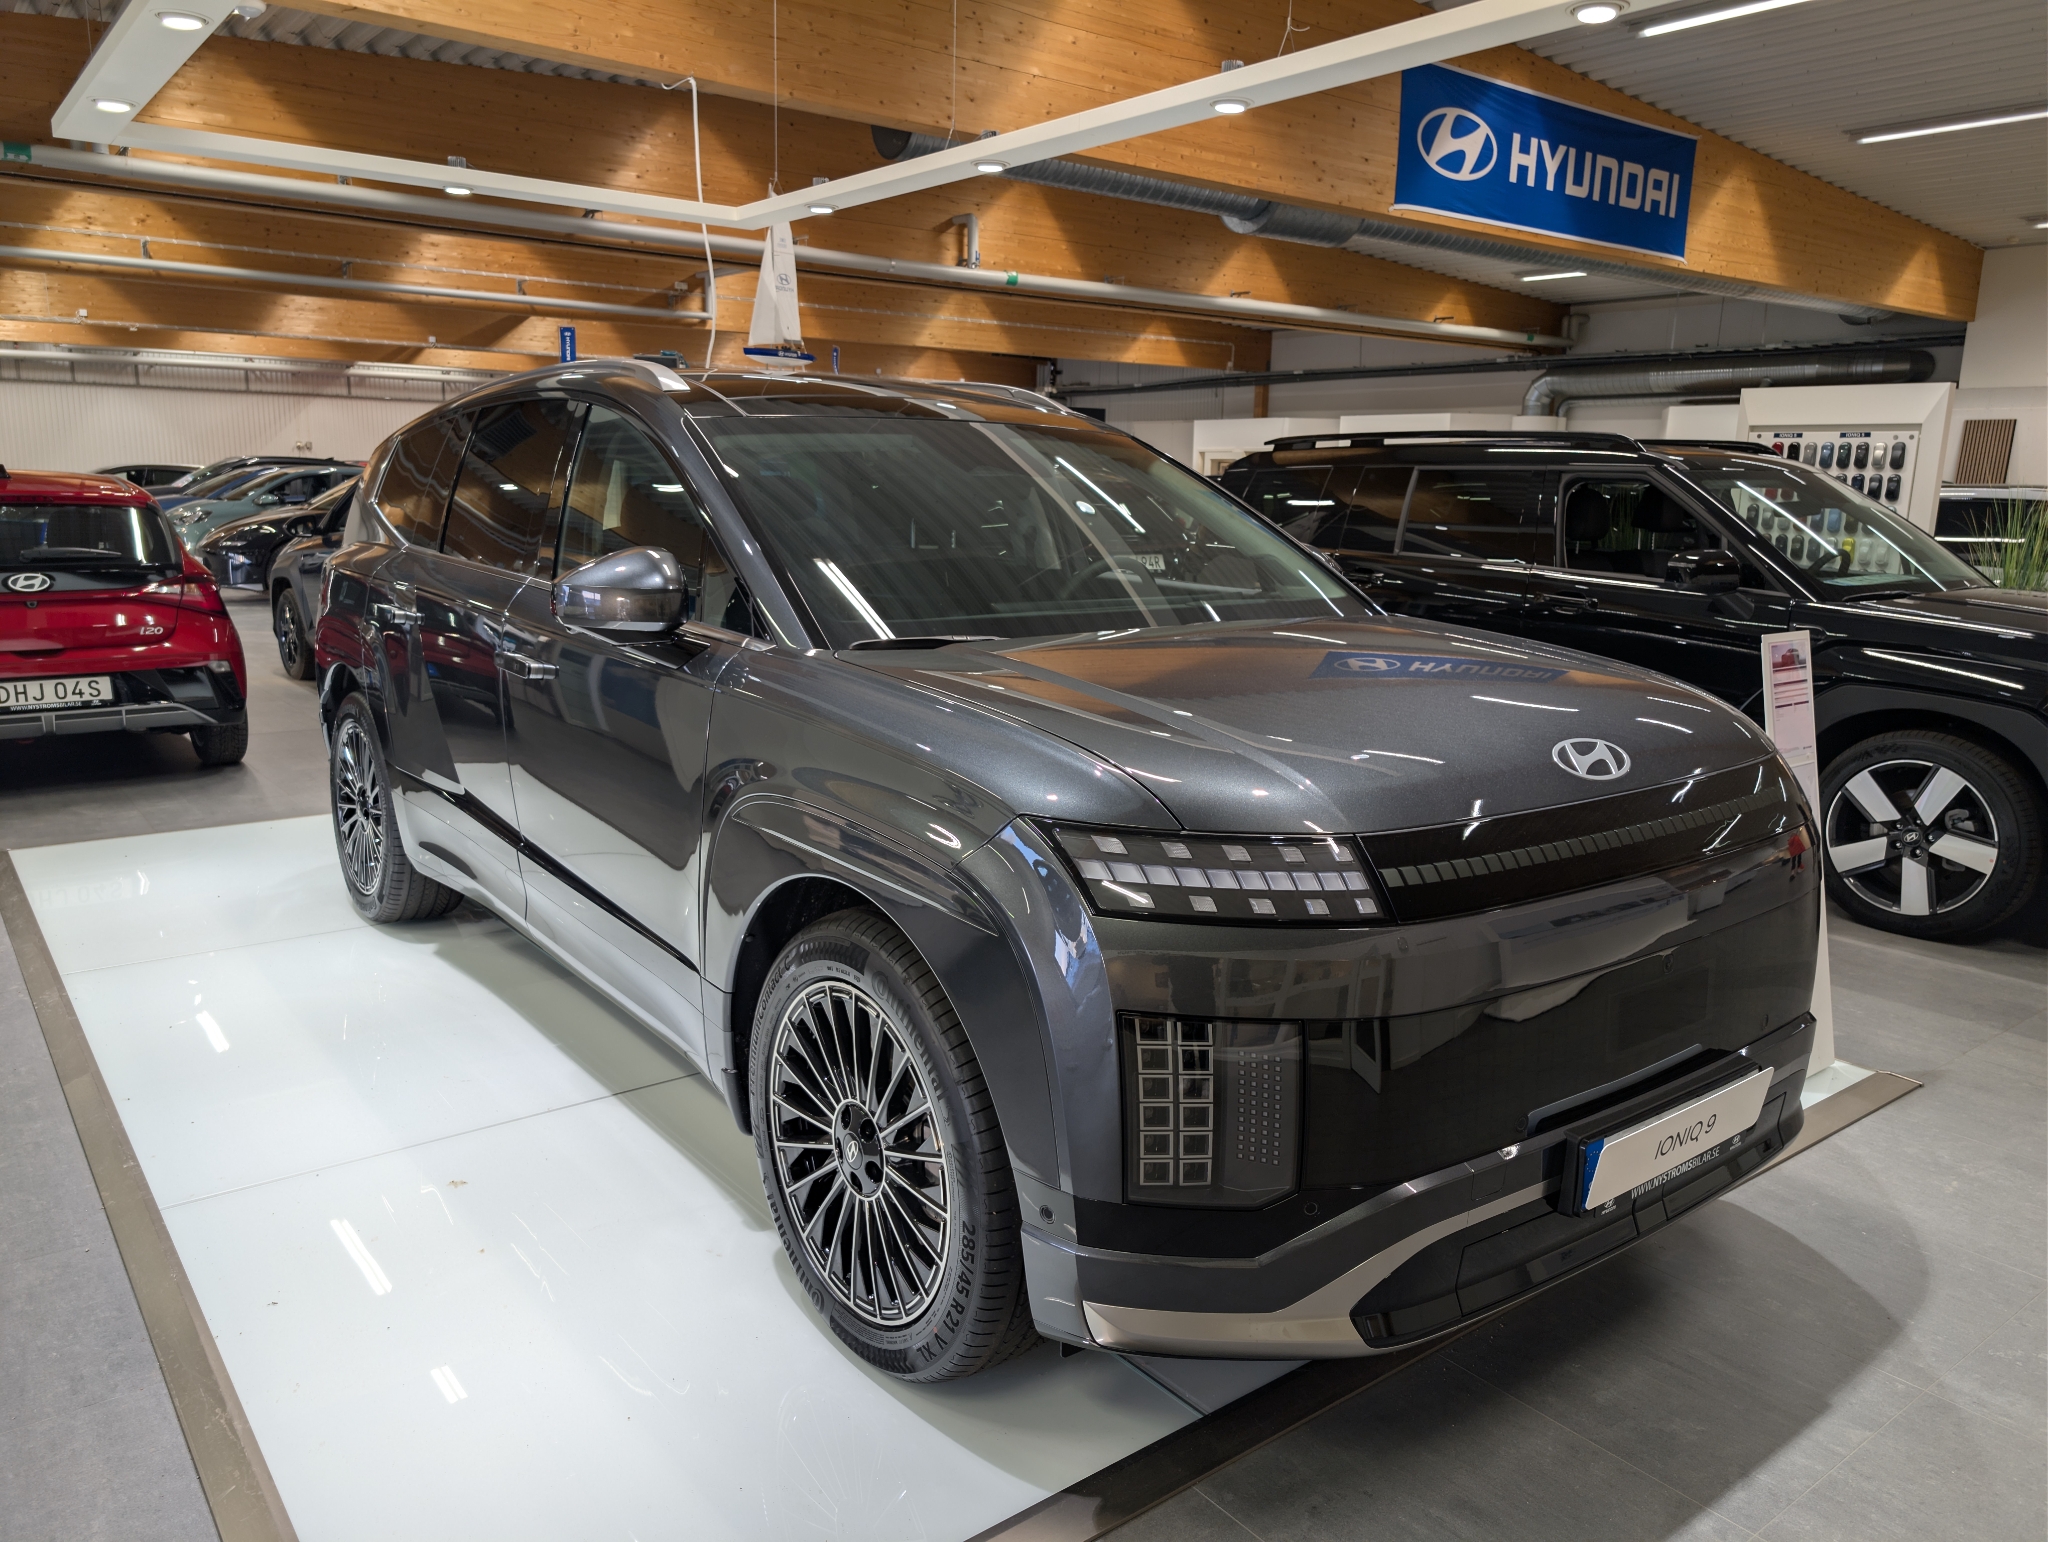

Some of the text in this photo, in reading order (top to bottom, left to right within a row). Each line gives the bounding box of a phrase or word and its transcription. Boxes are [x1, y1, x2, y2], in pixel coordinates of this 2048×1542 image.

[1509, 132, 1680, 218] HYUNDAI
[0, 680, 101, 704] DHJ 04S
[872, 970, 948, 1102] Continental
[1654, 1113, 1717, 1160] IONIQ 9
[1631, 1146, 1720, 1199] WWW.NYSTROMSBILAR.SE
[767, 1191, 825, 1314] Continental
[955, 1220, 977, 1299] 285/45
[935, 1333, 948, 1351] V
[943, 1300, 965, 1334] R21
[917, 1342, 937, 1362] XL
